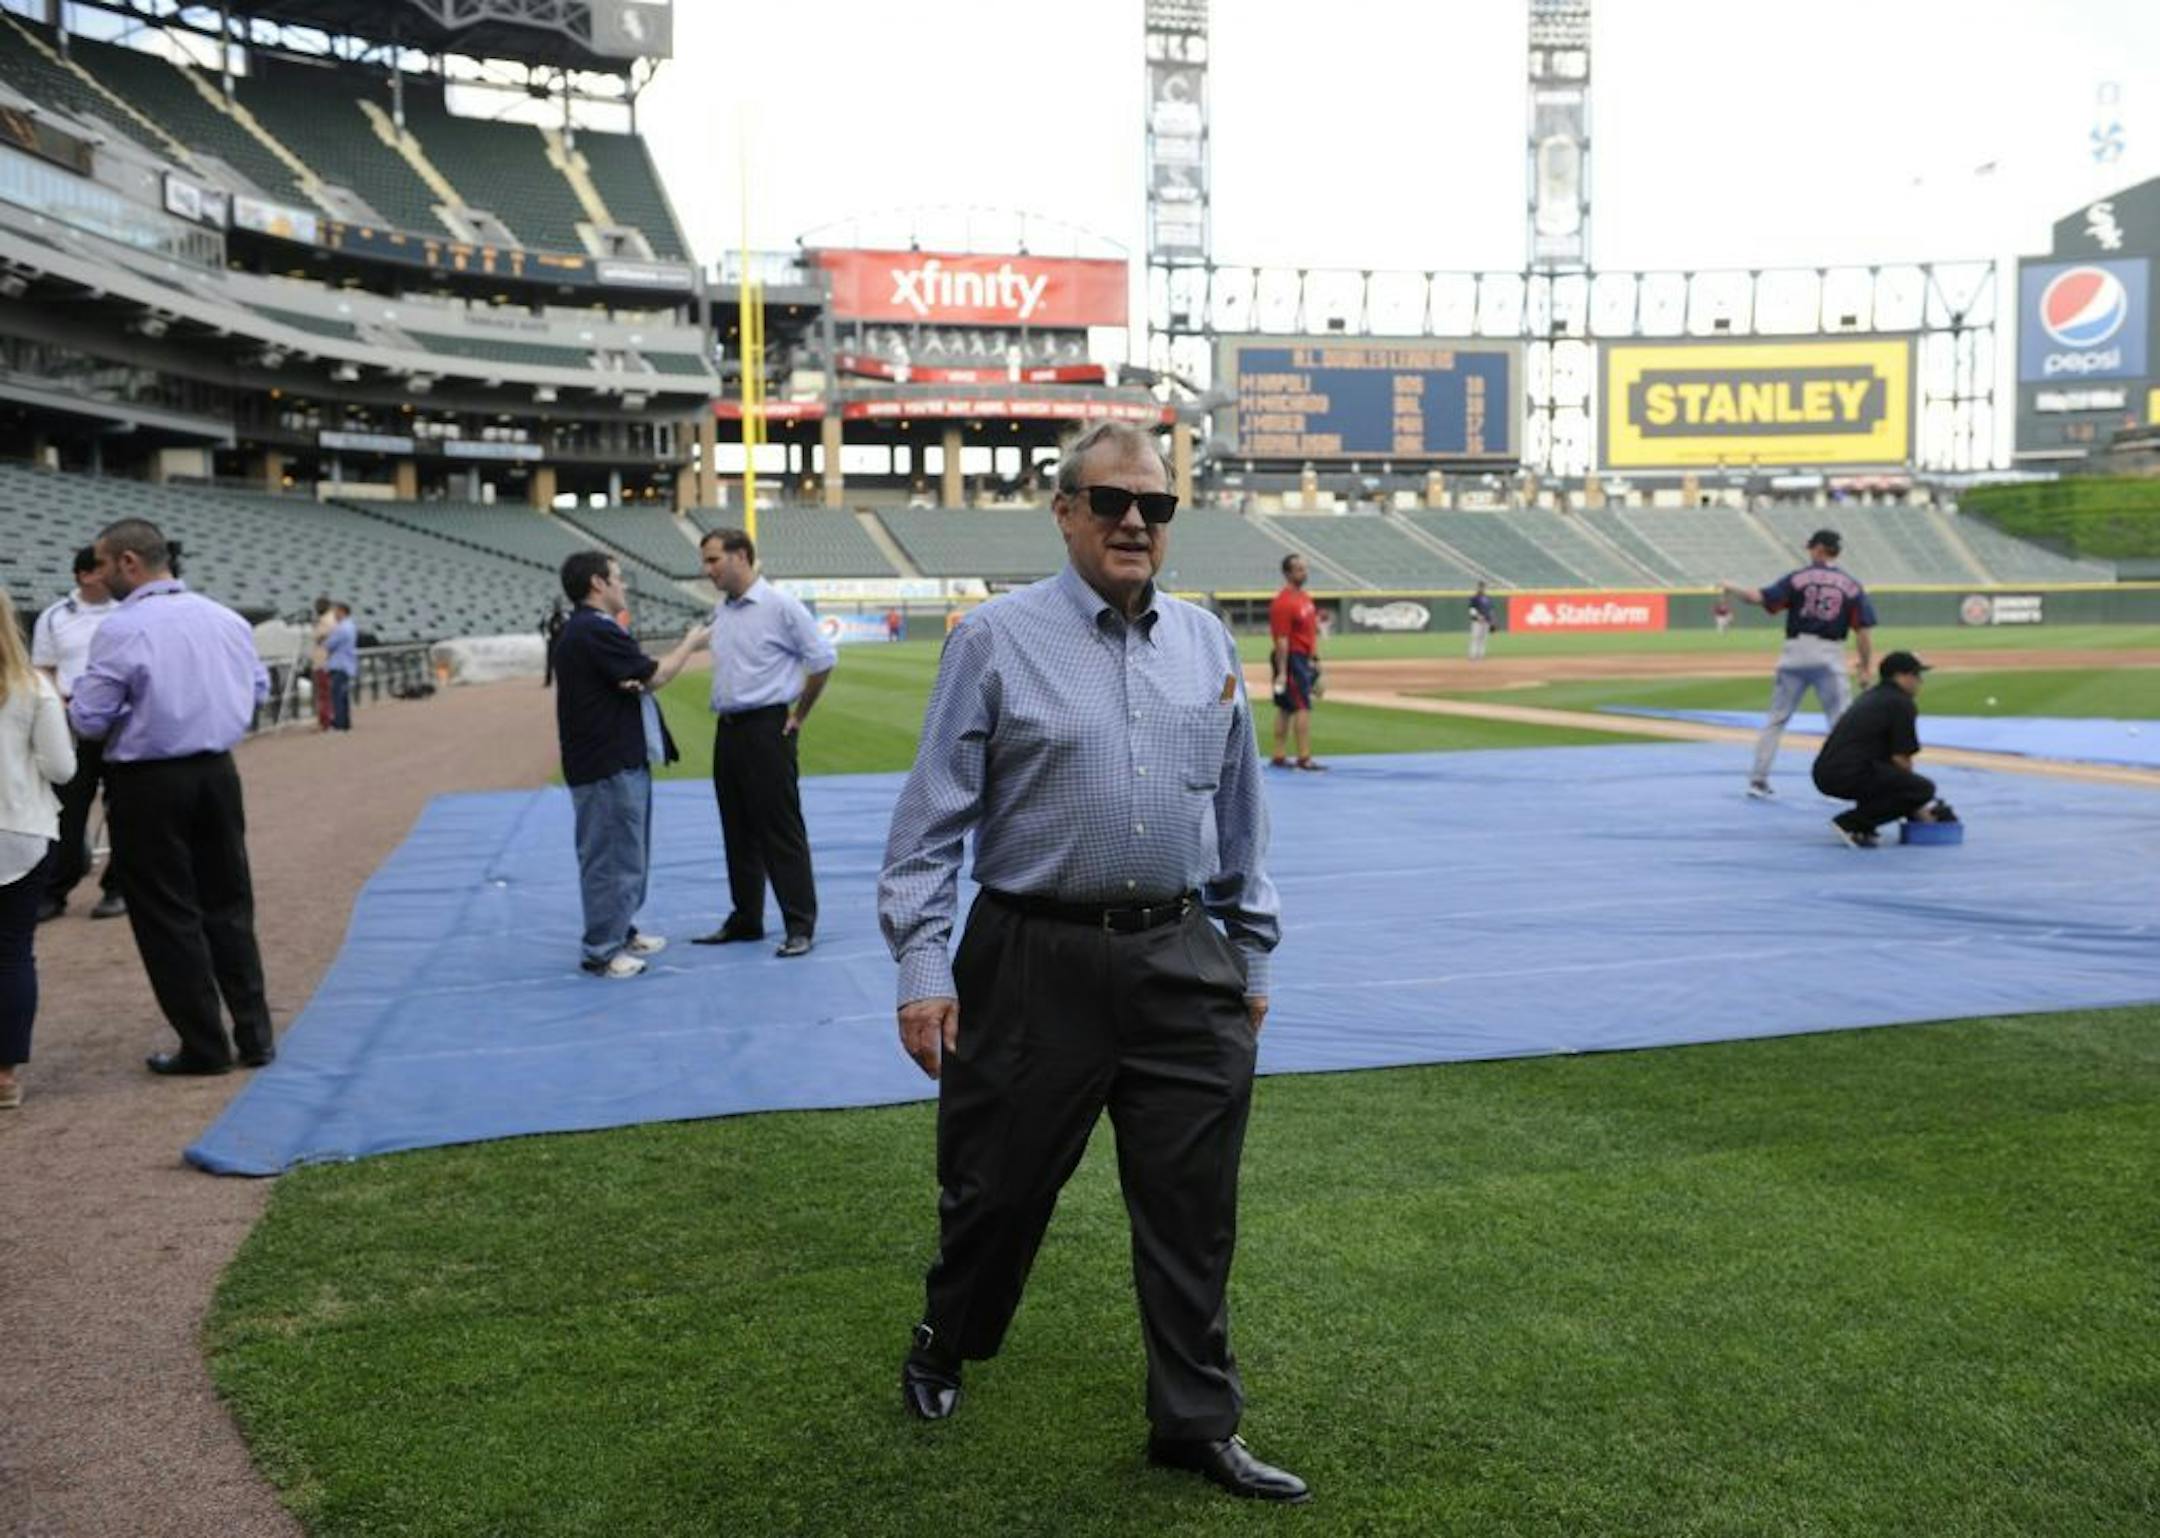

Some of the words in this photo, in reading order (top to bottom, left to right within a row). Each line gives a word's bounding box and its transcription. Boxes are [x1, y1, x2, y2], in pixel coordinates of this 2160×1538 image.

[890, 258, 1048, 319] xfinity
[2044, 346, 2121, 375] pepsi
[1645, 378, 1871, 426] STANLEY
